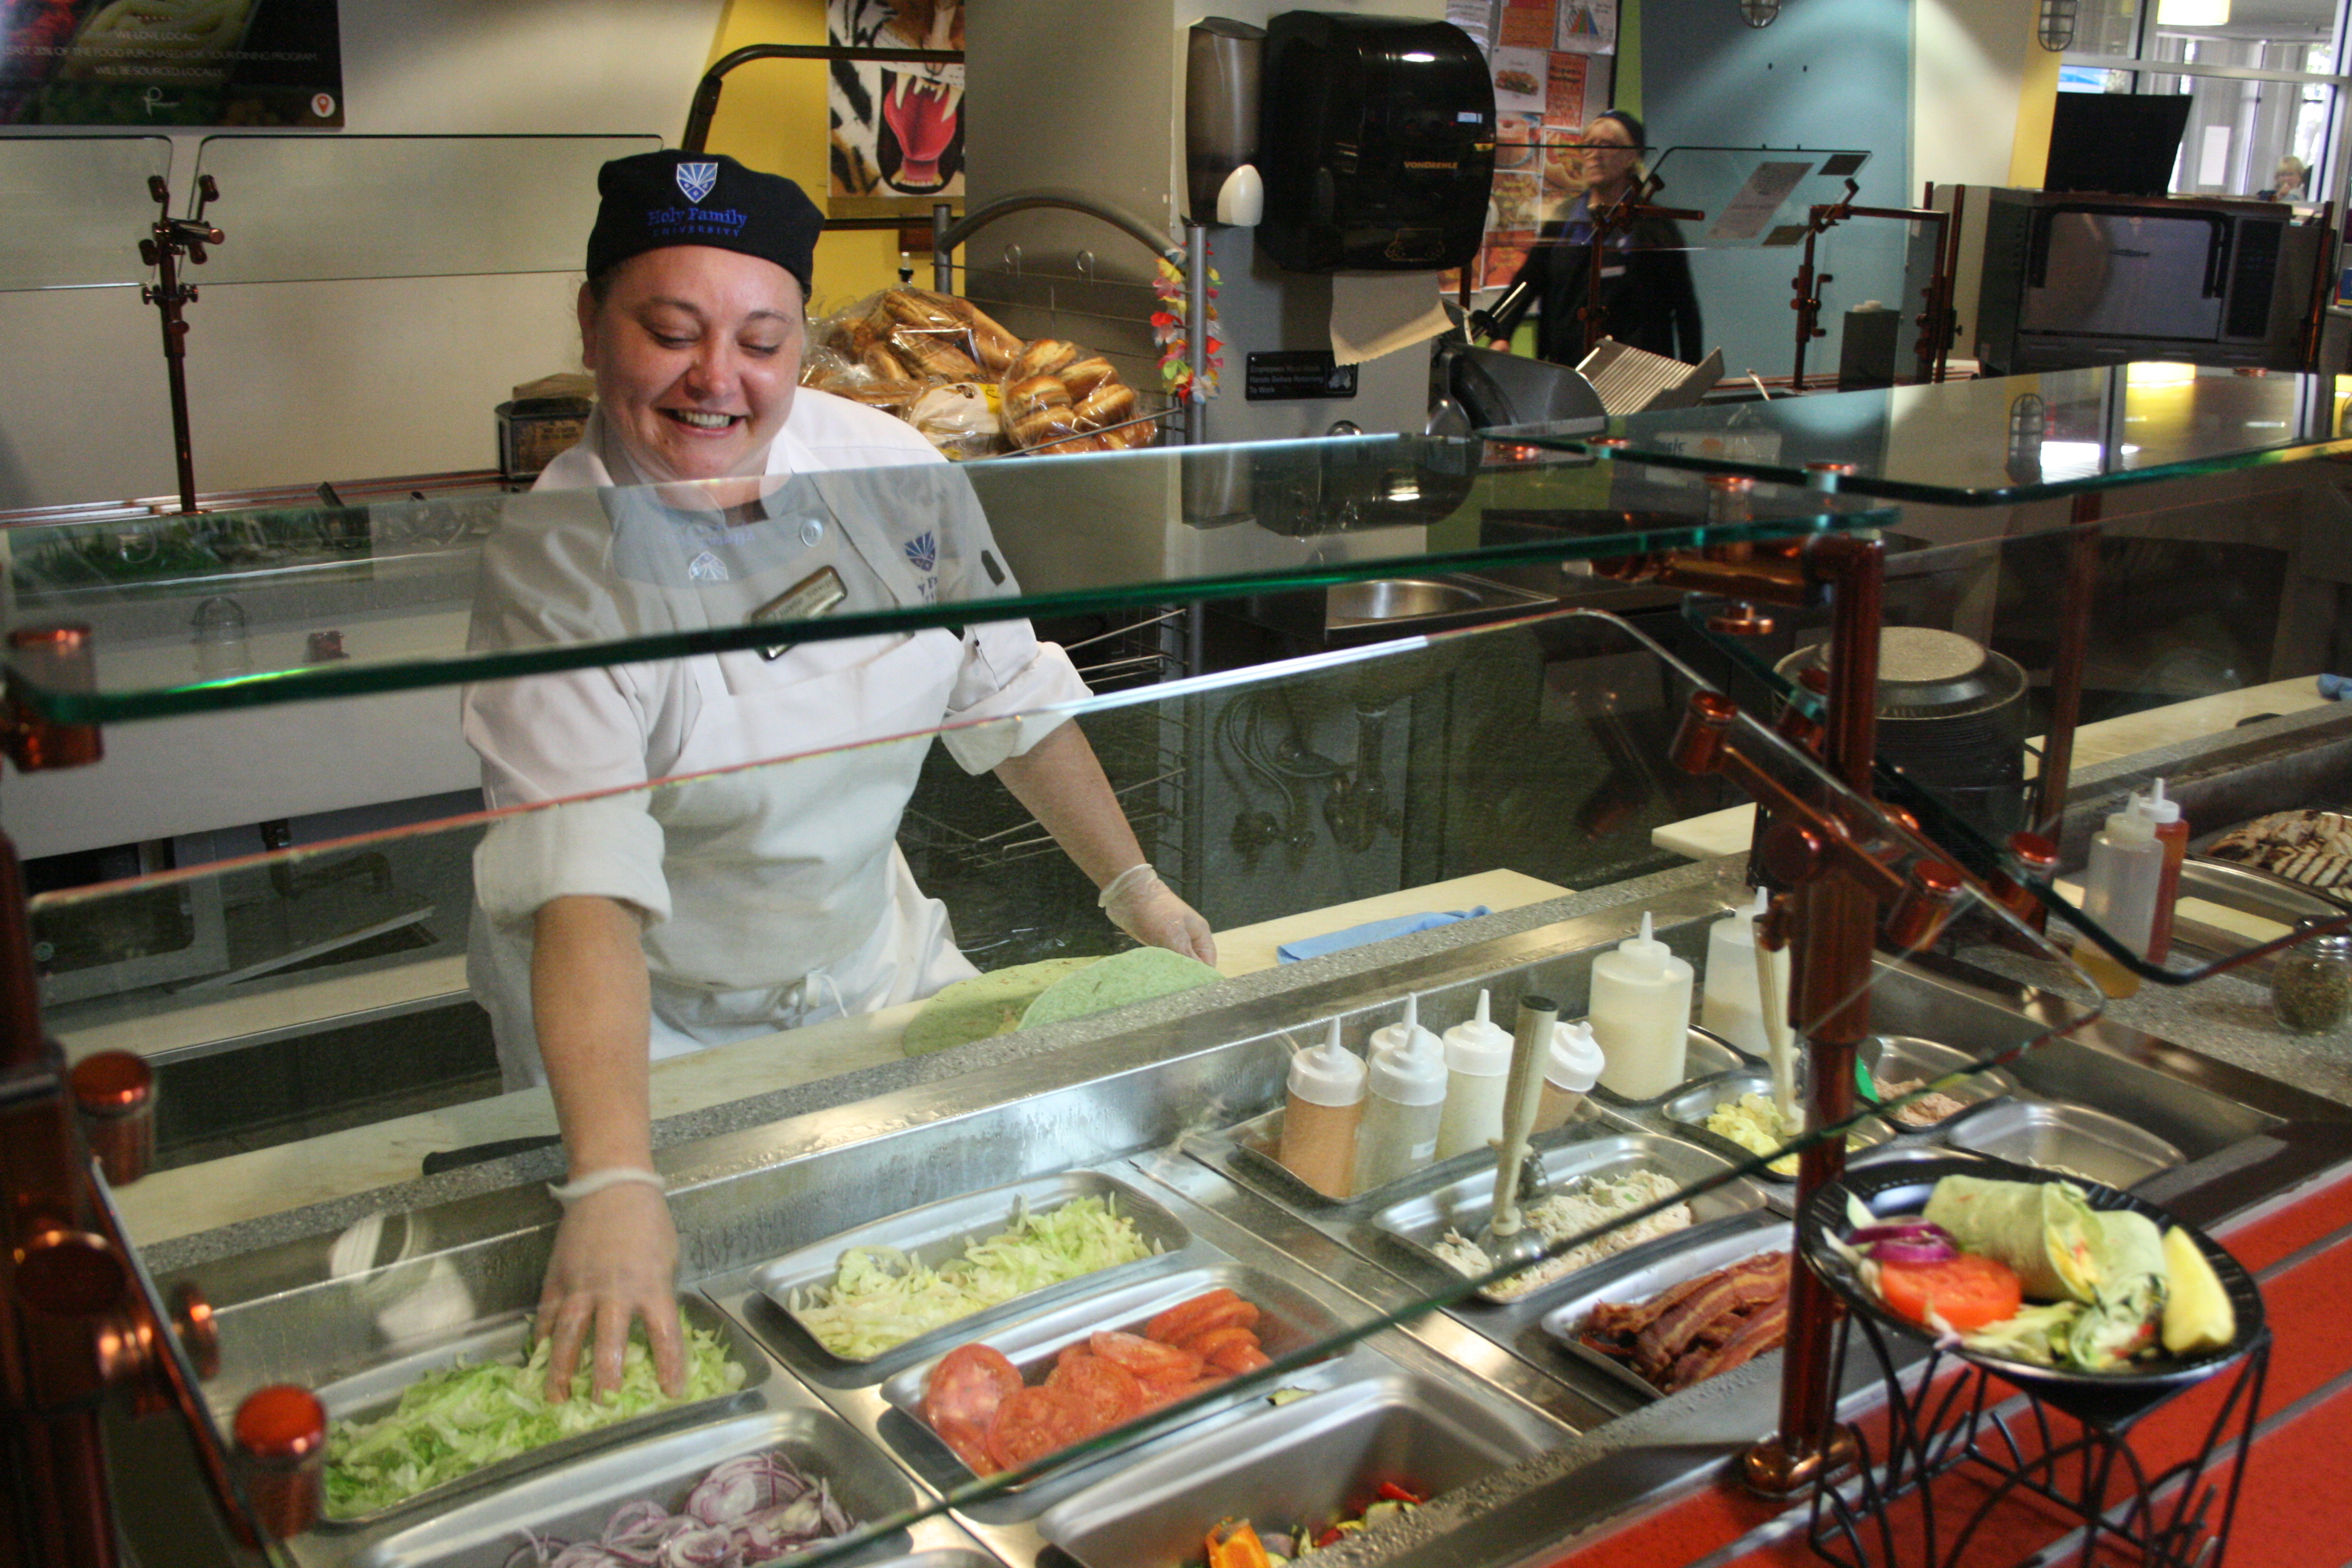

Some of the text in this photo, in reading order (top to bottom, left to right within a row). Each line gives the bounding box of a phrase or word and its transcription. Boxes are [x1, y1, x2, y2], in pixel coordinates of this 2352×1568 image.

[132, 32, 160, 41] LOVE
[54, 47, 69, 56] OF
[94, 48, 124, 57] FOOD
[125, 49, 183, 59] PURCHASED
[207, 50, 235, 60] YOUR
[236, 51, 270, 60] DINING
[272, 52, 318, 61] PROGRAM
[94, 66, 117, 75] WILL
[119, 67, 132, 76] BE
[134, 67, 180, 76] SOURCED
[647, 207, 748, 229] Holy Family
[653, 224, 740, 238] UNIVERSITY
[1250, 365, 1285, 374] Employees
[1293, 374, 1324, 384] Returning
